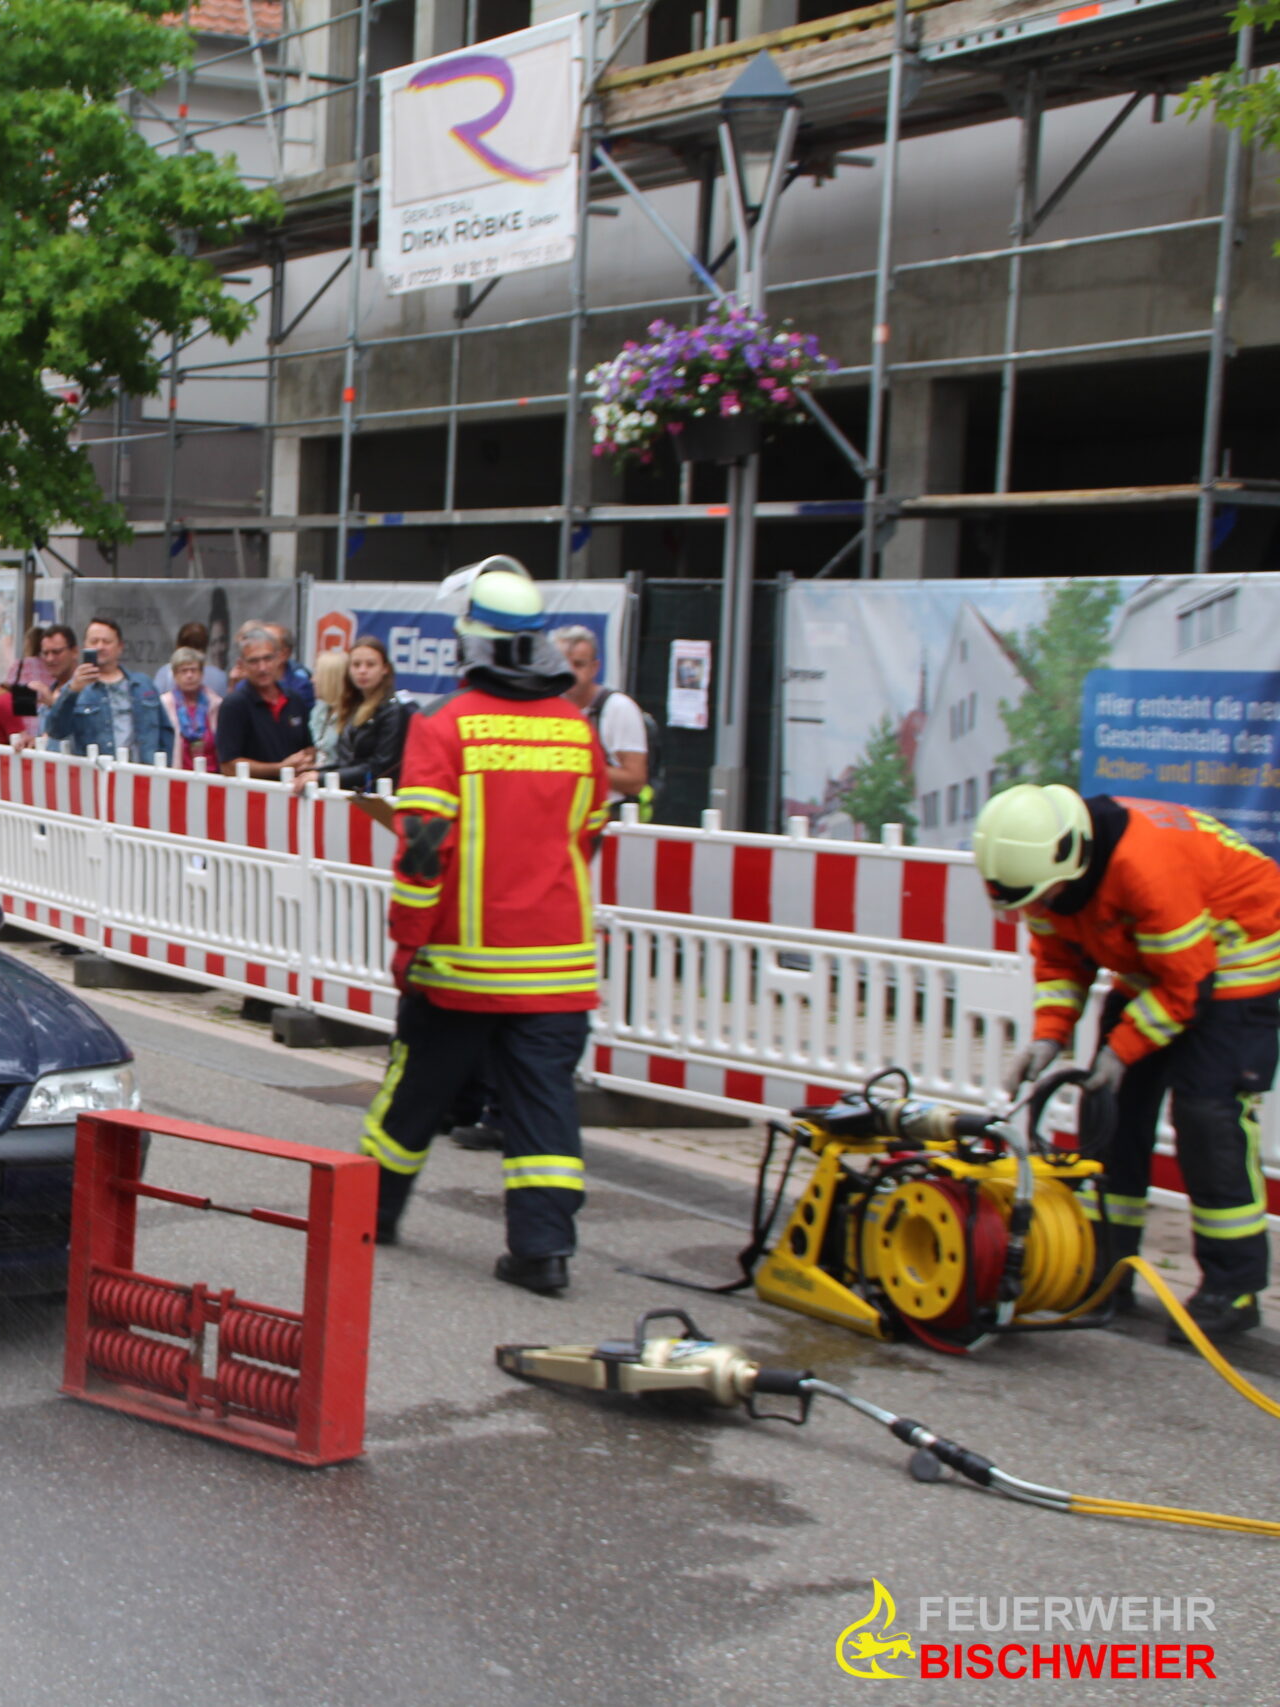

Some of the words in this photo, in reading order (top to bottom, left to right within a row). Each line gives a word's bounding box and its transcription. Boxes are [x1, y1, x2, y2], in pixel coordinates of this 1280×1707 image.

[400, 227, 450, 255] DIRK
[452, 208, 524, 243] RÖBKE
[388, 626, 462, 675] Eise
[1095, 692, 1134, 717] Hier
[1137, 694, 1212, 720] entsteht
[1213, 695, 1244, 721] die
[457, 714, 592, 744] FEUERWEHR
[1095, 723, 1231, 753] Geschäftsstelle
[1233, 729, 1273, 754] des
[463, 744, 592, 774] BISCHWEIER
[1156, 760, 1192, 783] und
